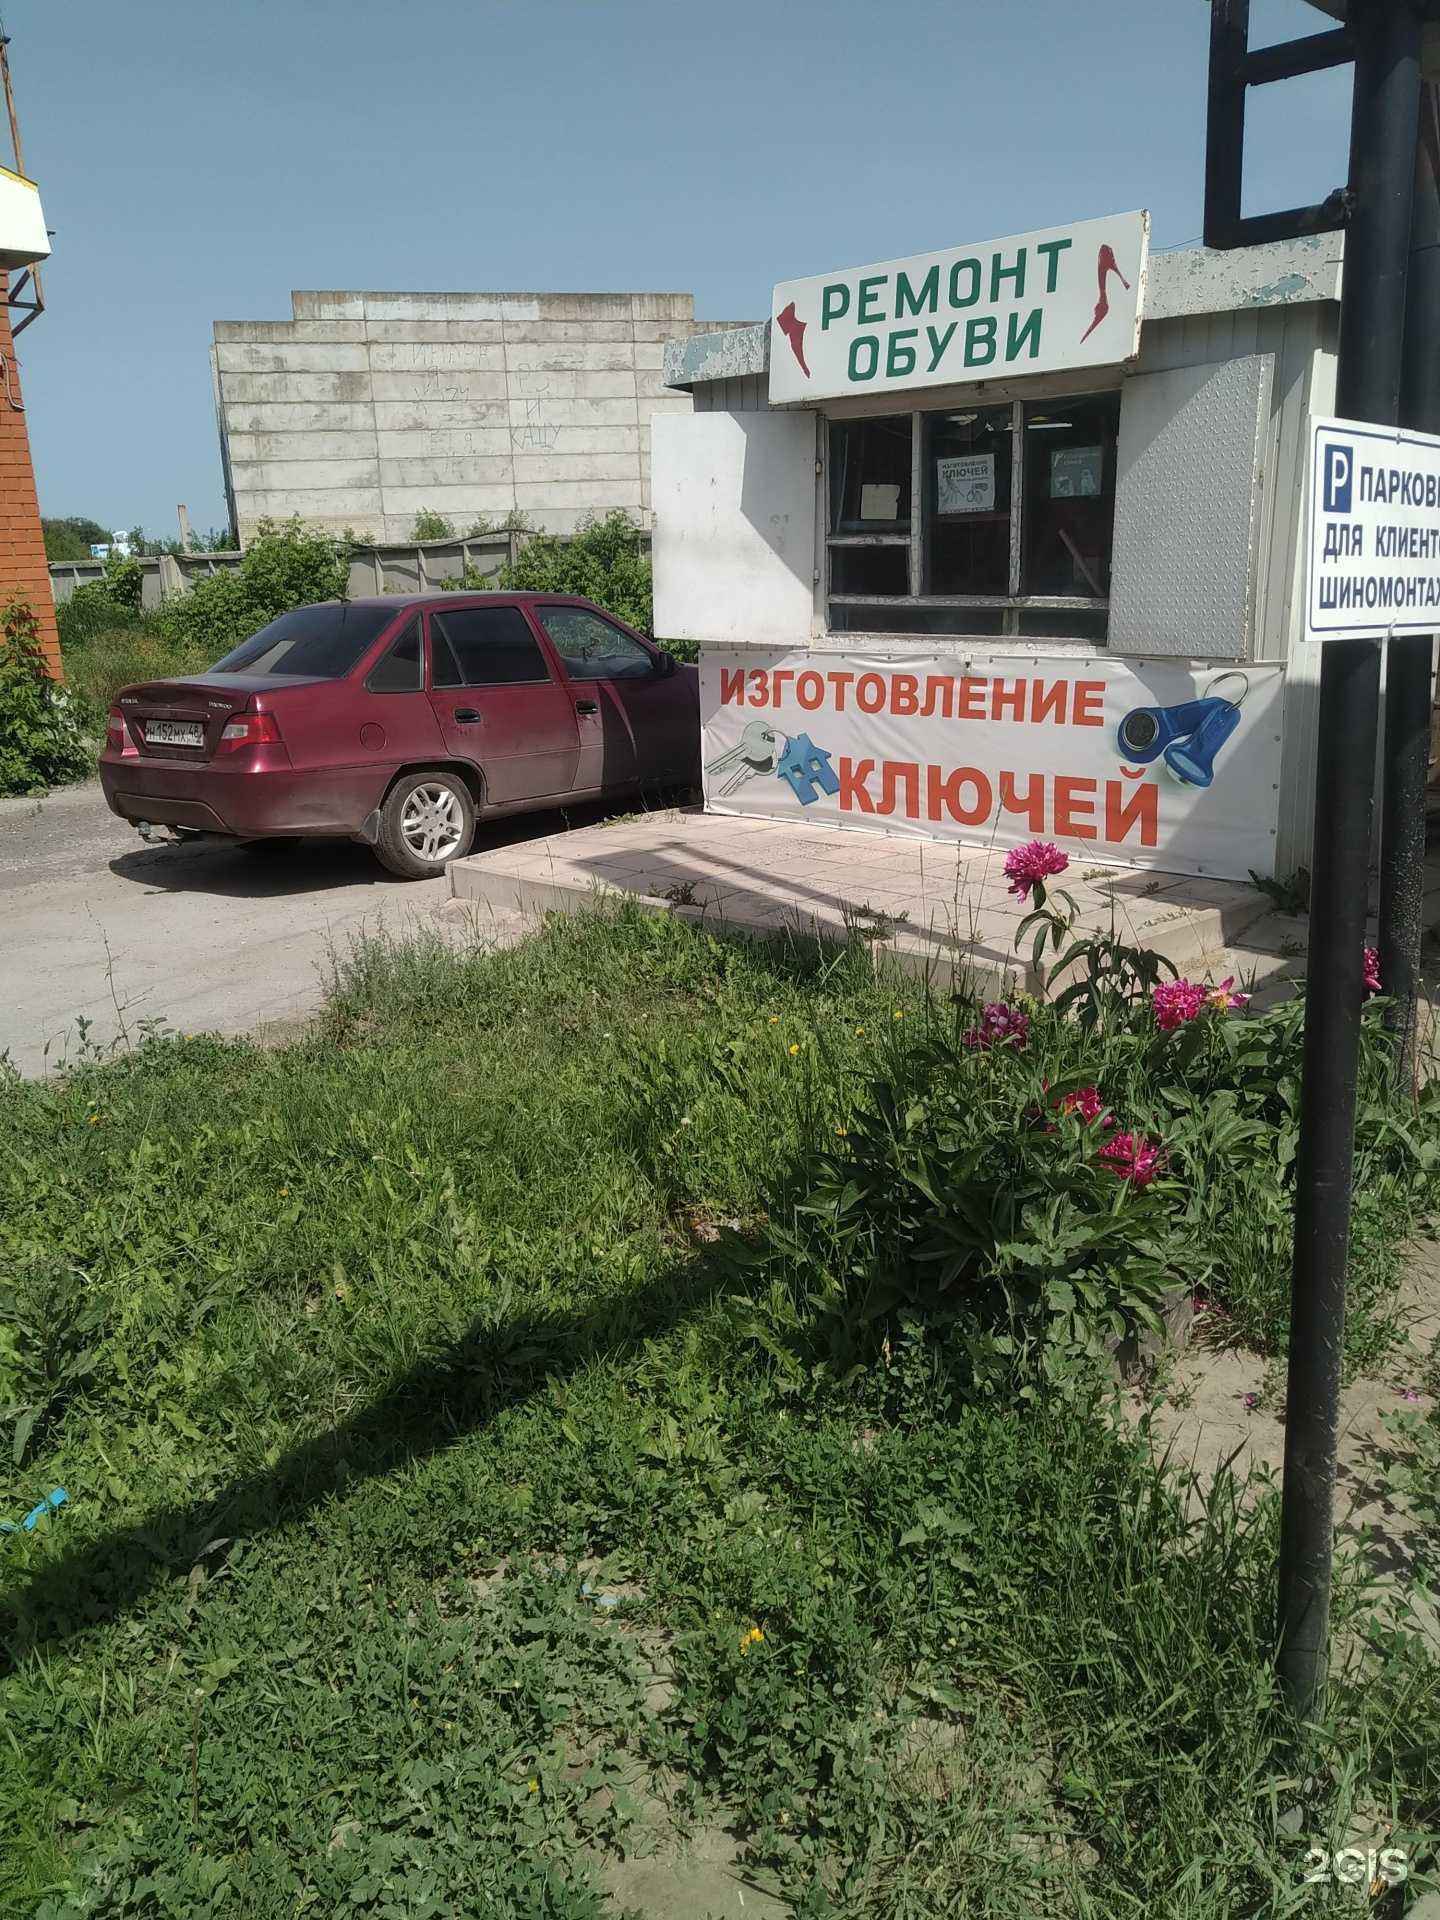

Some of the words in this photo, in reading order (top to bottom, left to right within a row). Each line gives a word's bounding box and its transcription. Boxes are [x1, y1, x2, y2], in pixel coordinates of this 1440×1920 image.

[821, 238, 1073, 331] РЕМОНТ
[847, 308, 1044, 382] ОБУВИ
[1322, 522, 1363, 564] ДЛЯ
[1375, 525, 1440, 560] КЛИЕНТ
[720, 668, 1106, 727] ИЗГОТОВЛЕНИЕ
[839, 756, 1159, 847] КЛЮЧЕЙ
